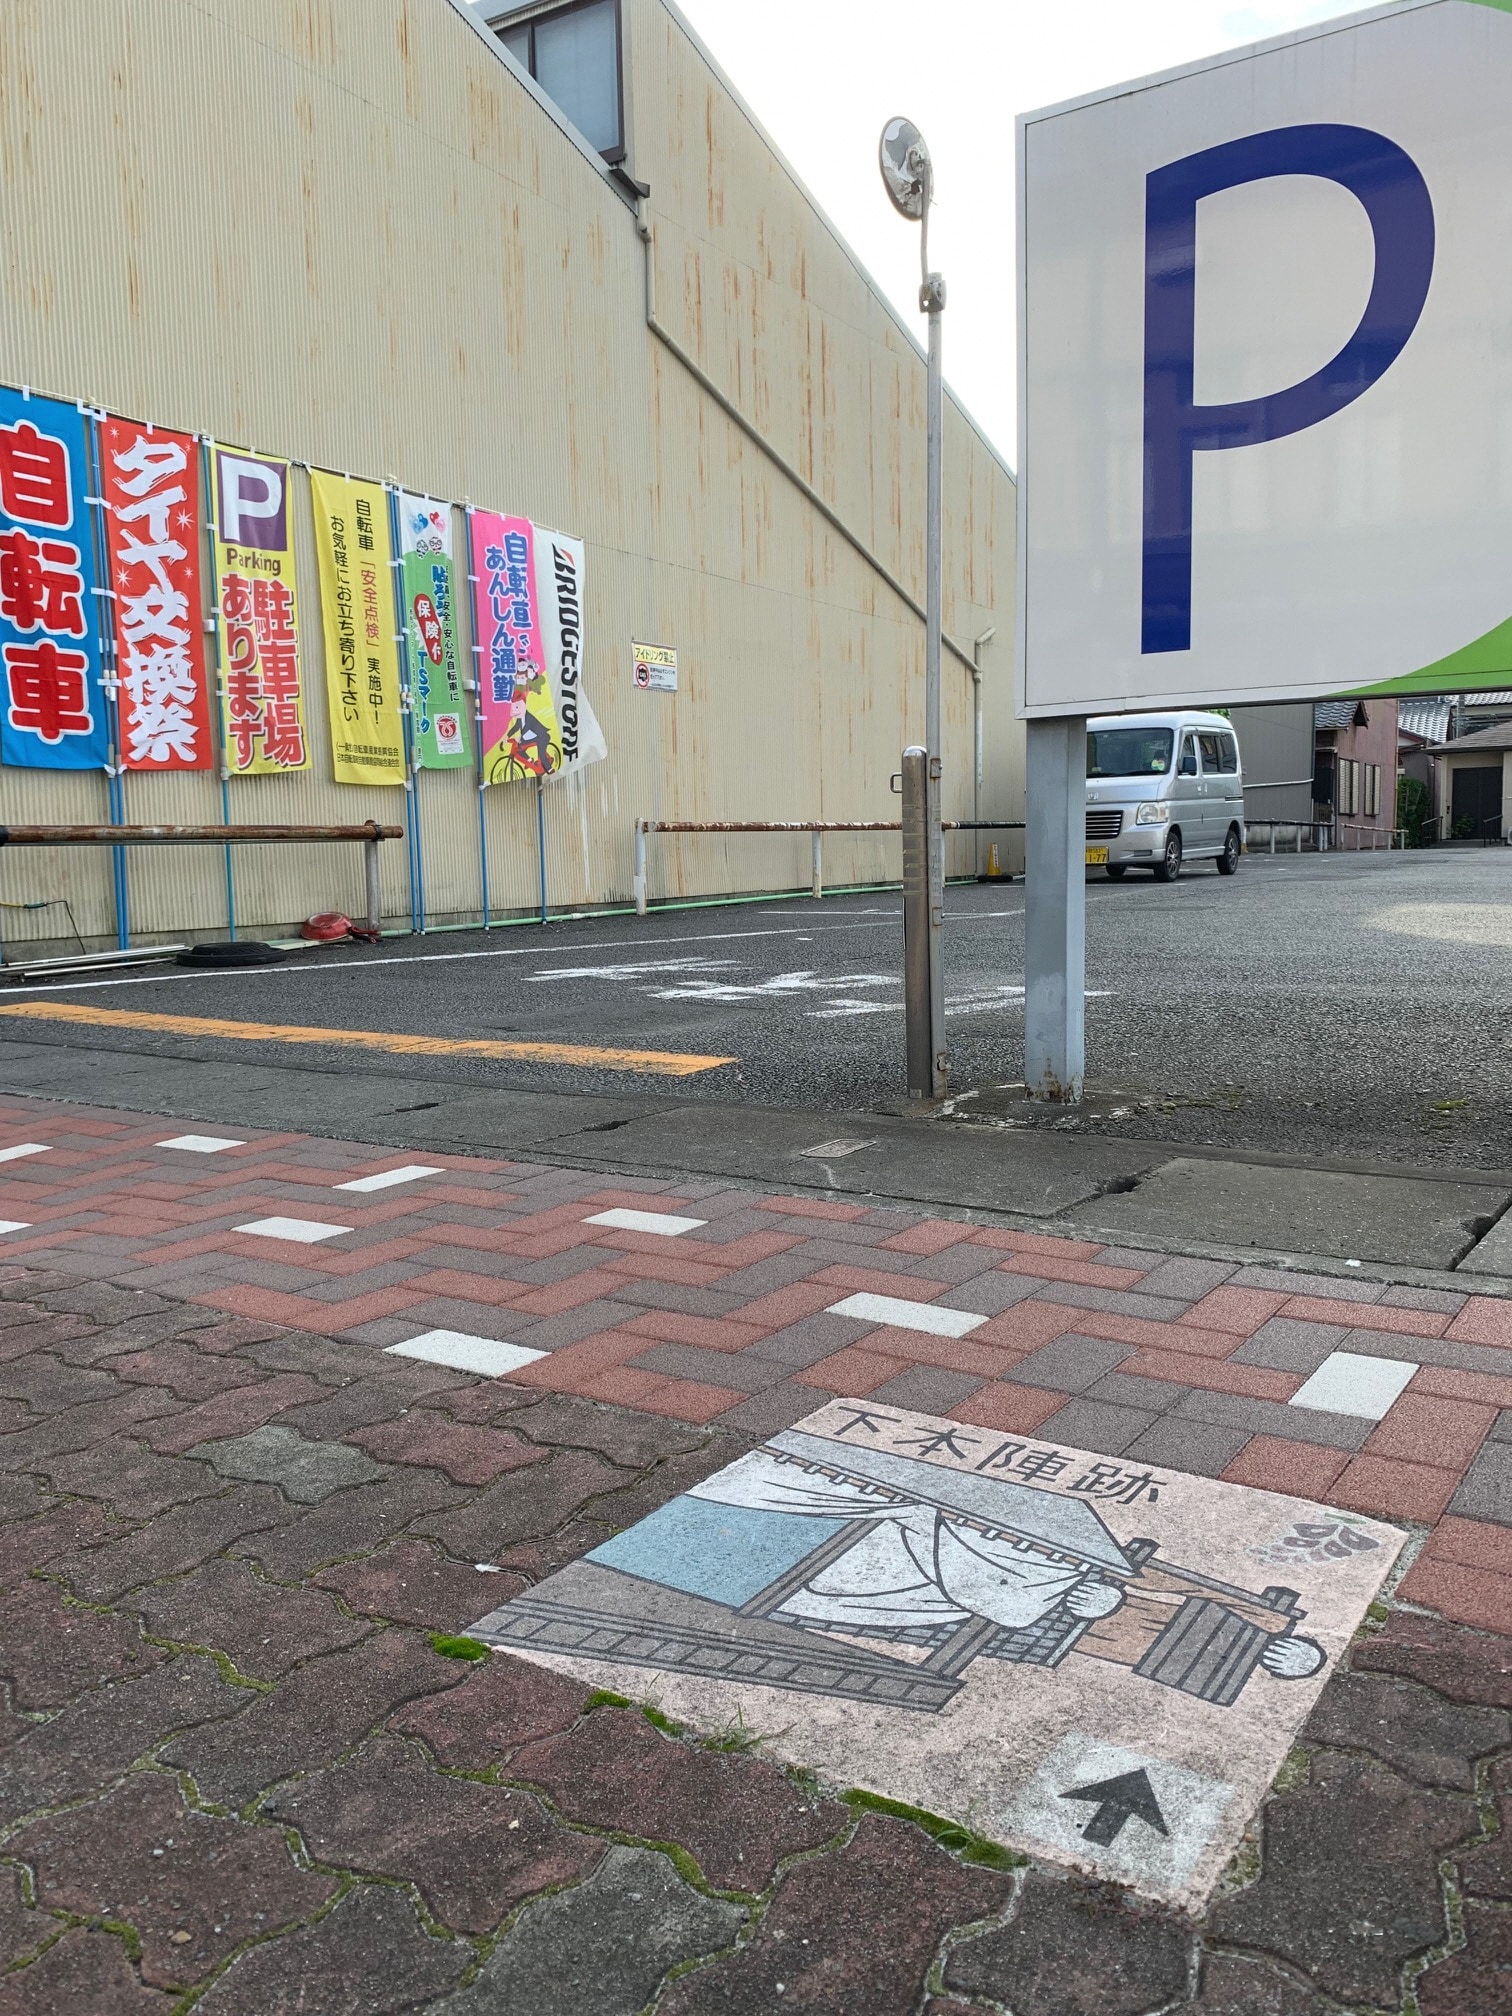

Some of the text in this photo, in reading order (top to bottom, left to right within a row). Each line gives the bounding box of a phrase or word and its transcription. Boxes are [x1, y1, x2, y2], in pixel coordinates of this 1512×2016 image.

[1142, 123, 1435, 654] P
[0, 422, 92, 742] 自転車
[220, 454, 282, 542] P
[226, 548, 281, 575] Parking
[356, 499, 374, 551] 自転車
[111, 435, 199, 762] タイヤ交換祭
[222, 573, 263, 769] あります
[252, 579, 305, 767] 駐車場
[330, 515, 359, 721] お気軽にお立ち寄り下さい
[486, 546, 516, 702] あんしん通勤
[418, 651, 431, 734] TSマーク
[834, 1406, 1167, 1504] 下本陣跡
